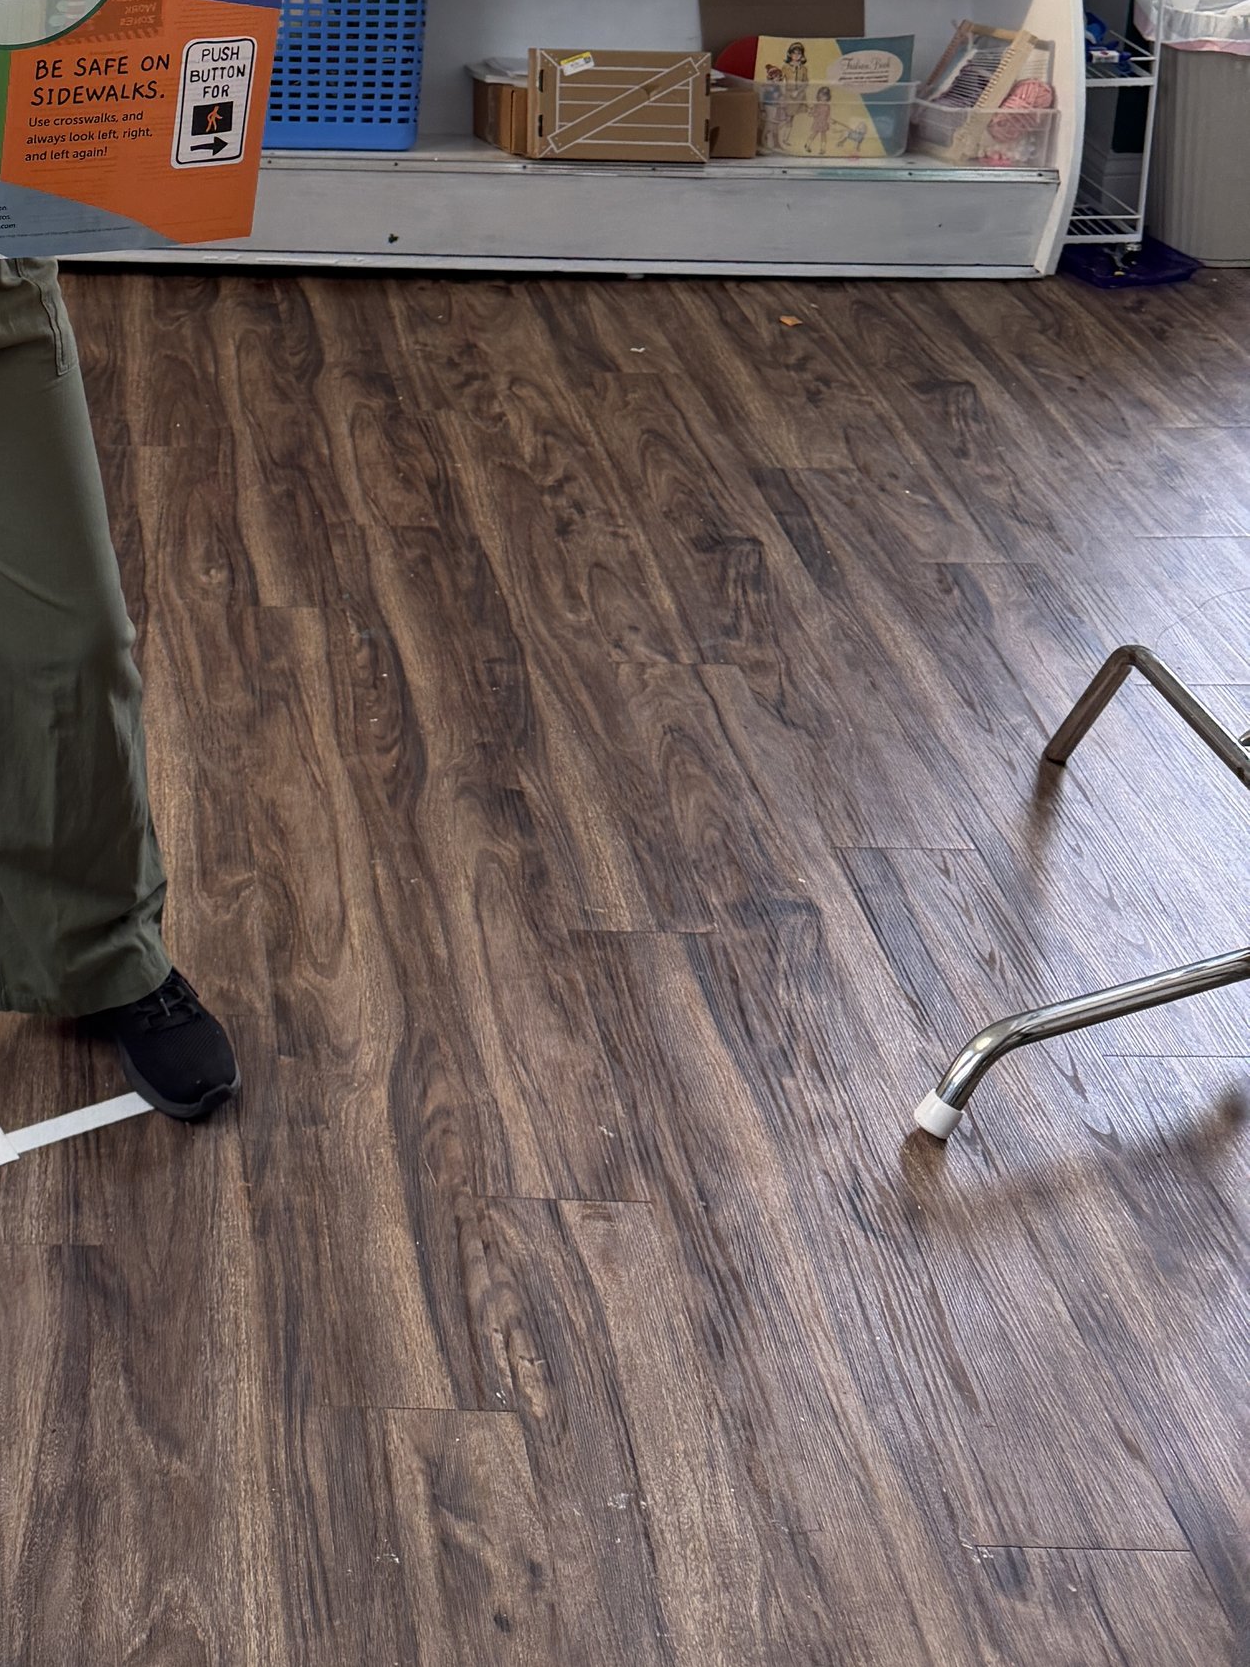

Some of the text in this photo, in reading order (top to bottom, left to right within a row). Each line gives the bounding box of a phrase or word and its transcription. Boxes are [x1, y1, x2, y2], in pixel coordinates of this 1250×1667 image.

[201, 46, 240, 62] PUSH
[35, 53, 170, 80] BE SAFE ON
[189, 64, 246, 83] BUTTON
[30, 80, 165, 107] SIDEWALKS.
[203, 85, 230, 98] FOR
[28, 111, 143, 127] Use crosswalks, and
[26, 133, 66, 146] always
[68, 131, 93, 142] look
[97, 130, 119, 141] left,
[25, 146, 108, 162] and left again!
